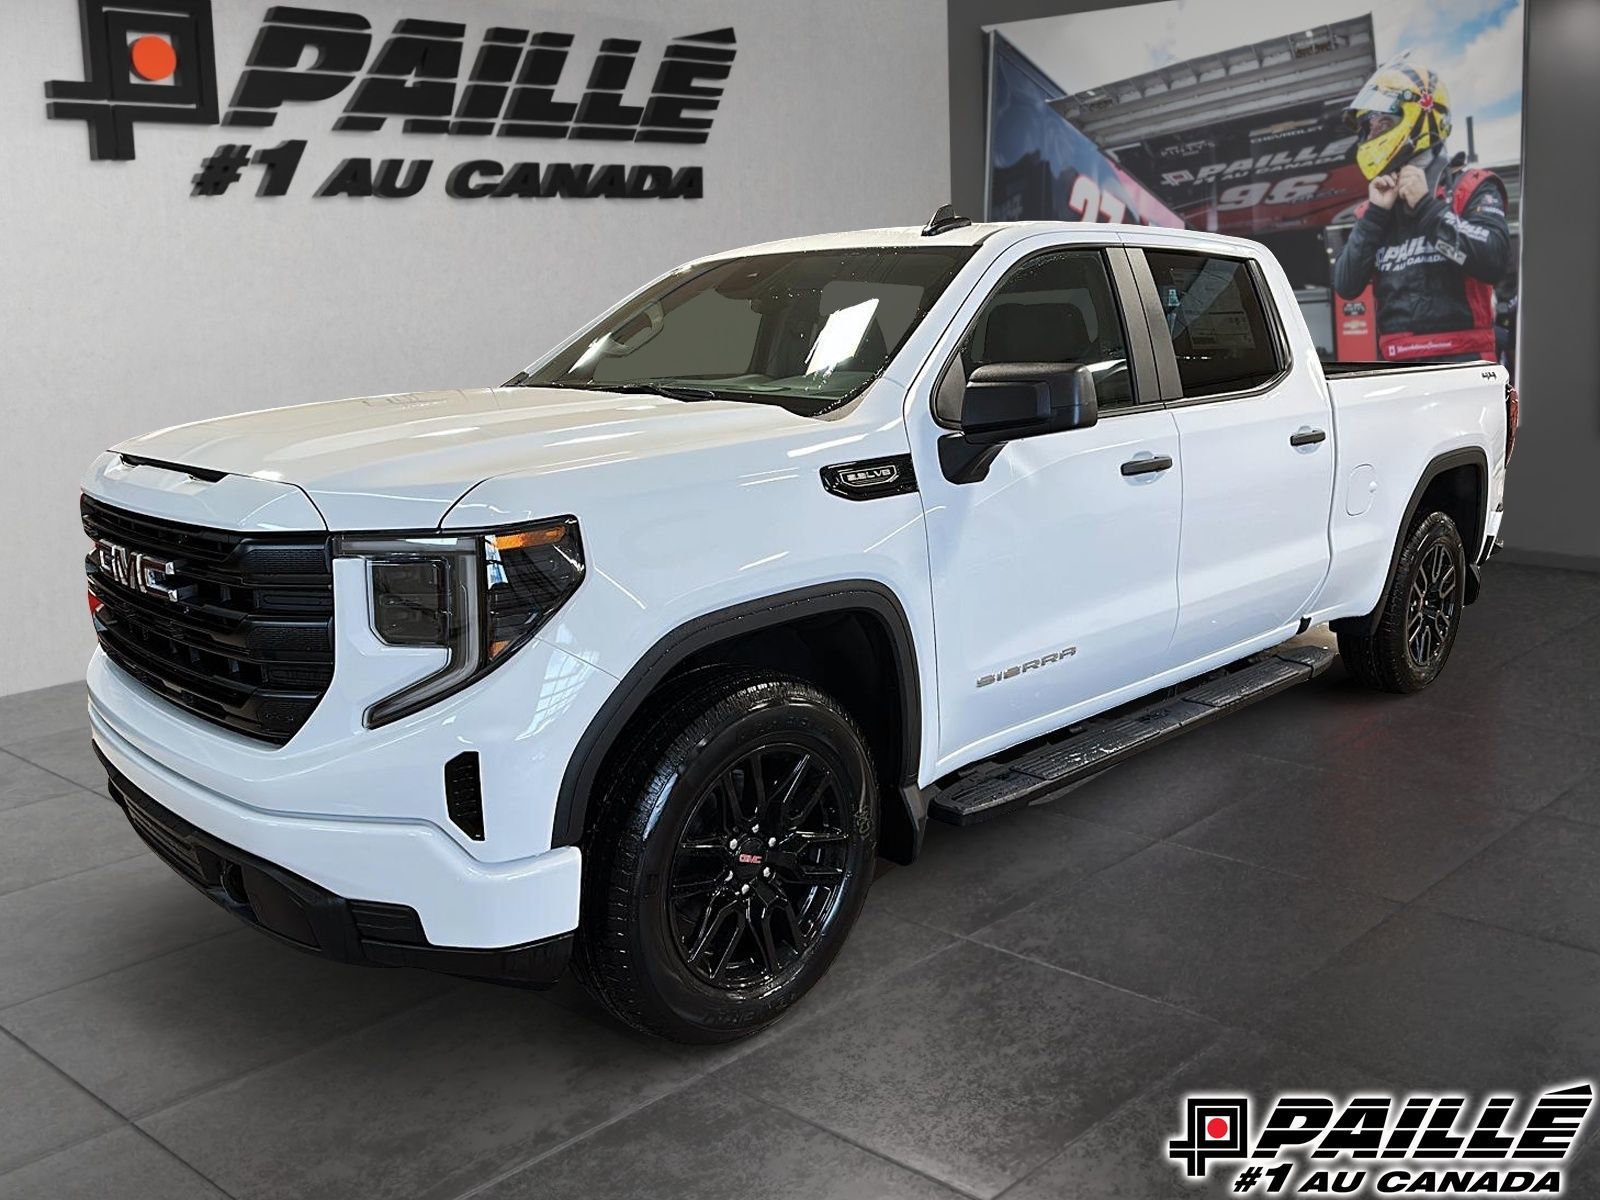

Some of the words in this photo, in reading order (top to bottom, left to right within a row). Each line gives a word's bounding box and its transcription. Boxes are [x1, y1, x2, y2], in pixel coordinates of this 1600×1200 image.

[220, 5, 738, 144] PAILLÉ
[190, 139, 308, 199] #1
[313, 158, 434, 200] AU
[445, 159, 705, 201] CANADA
[1217, 172, 1329, 212] 96
[1383, 235, 1437, 263] PAIL
[97, 538, 178, 603] GMC
[976, 646, 1077, 688] SIERRA
[739, 853, 762, 864] GMC
